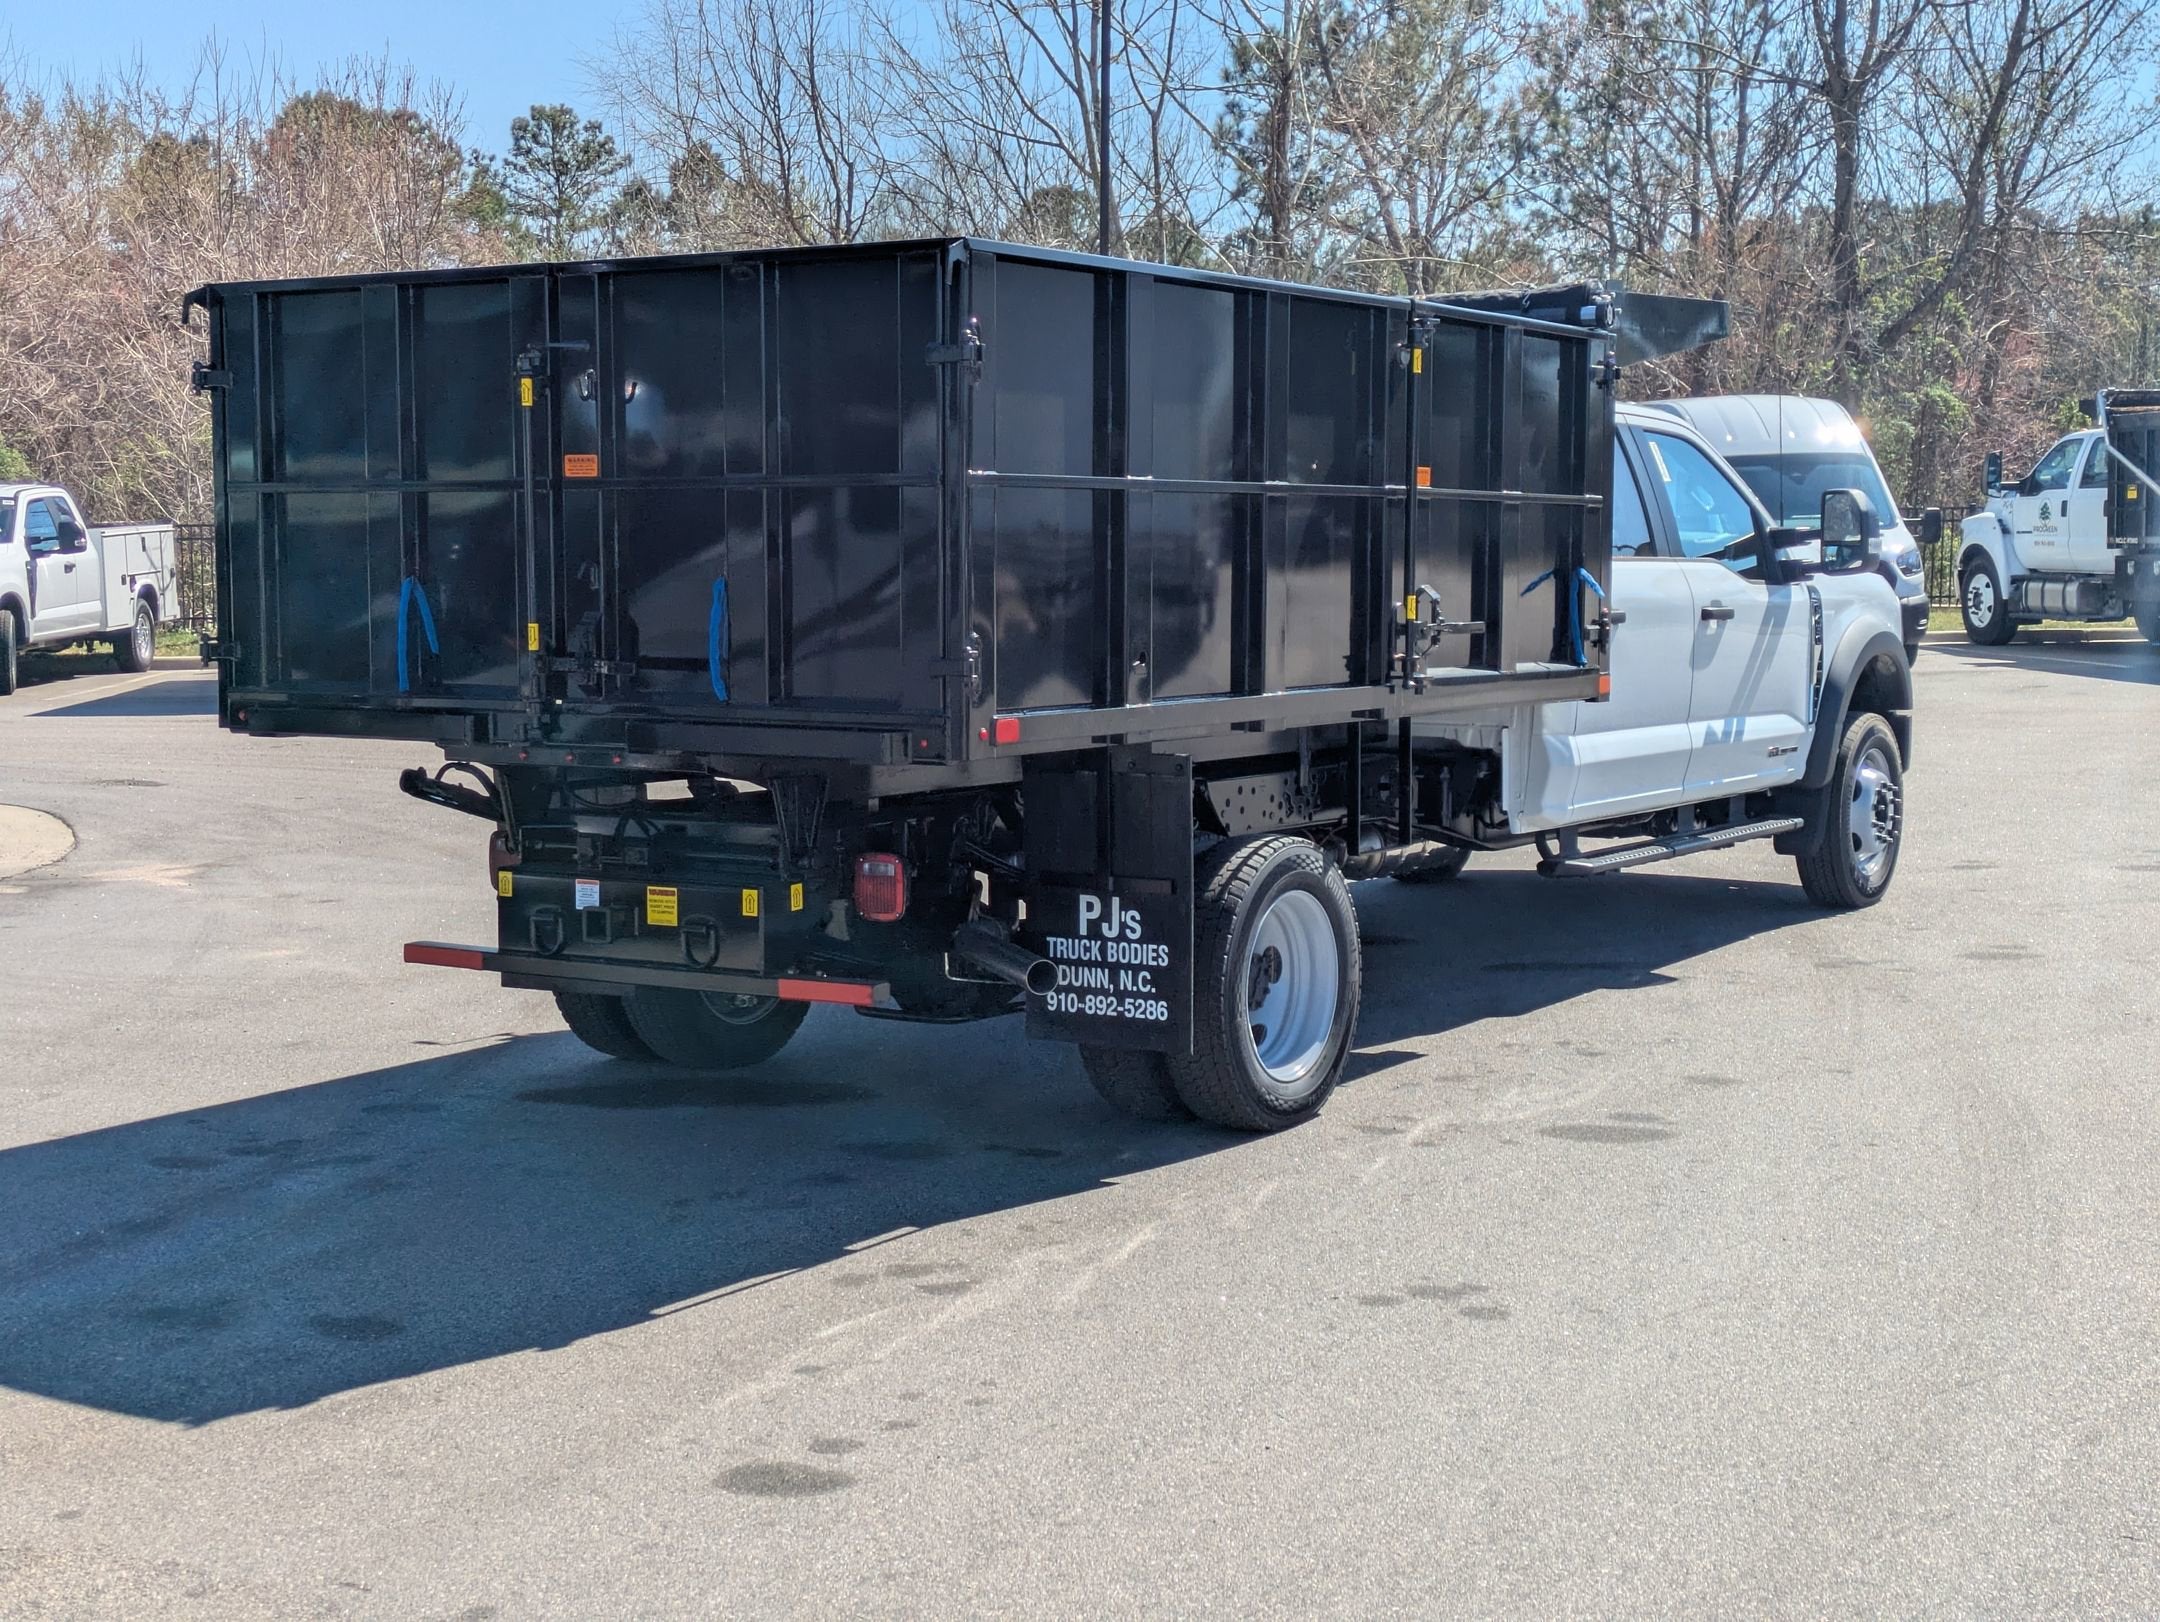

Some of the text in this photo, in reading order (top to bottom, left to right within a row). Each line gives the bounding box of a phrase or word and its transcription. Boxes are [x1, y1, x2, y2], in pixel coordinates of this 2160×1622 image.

[1046, 937, 1169, 967] TRUCK BODIES
[1058, 964, 1156, 993] DUNN, N.C.
[1046, 991, 1168, 1021] 910-892-5286
